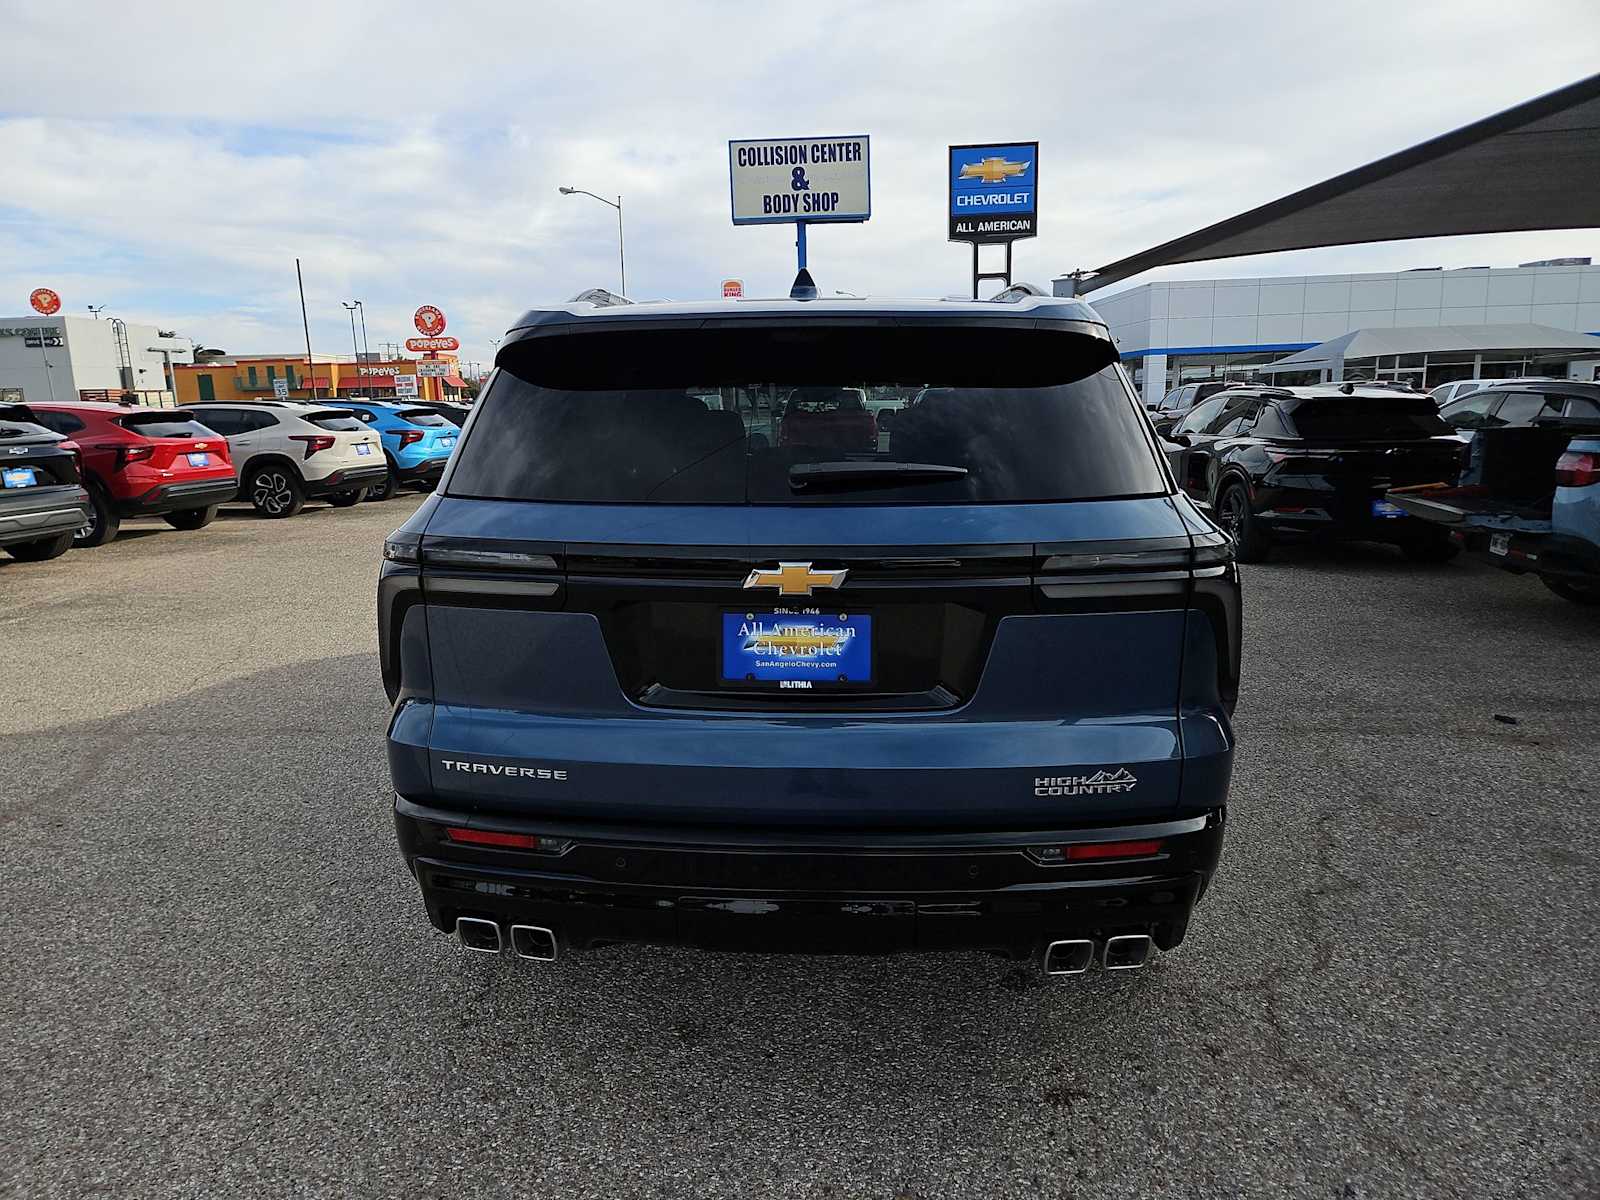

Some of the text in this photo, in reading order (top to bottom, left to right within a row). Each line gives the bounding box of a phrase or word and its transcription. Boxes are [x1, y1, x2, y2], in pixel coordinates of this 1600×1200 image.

[738, 142, 862, 167] COLLISION CENTER
[791, 166, 810, 191] &
[763, 192, 839, 214] BODY SHOP
[956, 192, 1030, 207] CHEVROLET
[955, 219, 1031, 233] ALL AMERICAN
[738, 622, 857, 638] All American
[753, 641, 842, 656] Chevrolet
[755, 660, 837, 668] SanAngeloChevy.com
[441, 760, 568, 780] TRAVERSE
[1034, 776, 1088, 787] HIGH
[1034, 783, 1137, 796] COUNTRY
